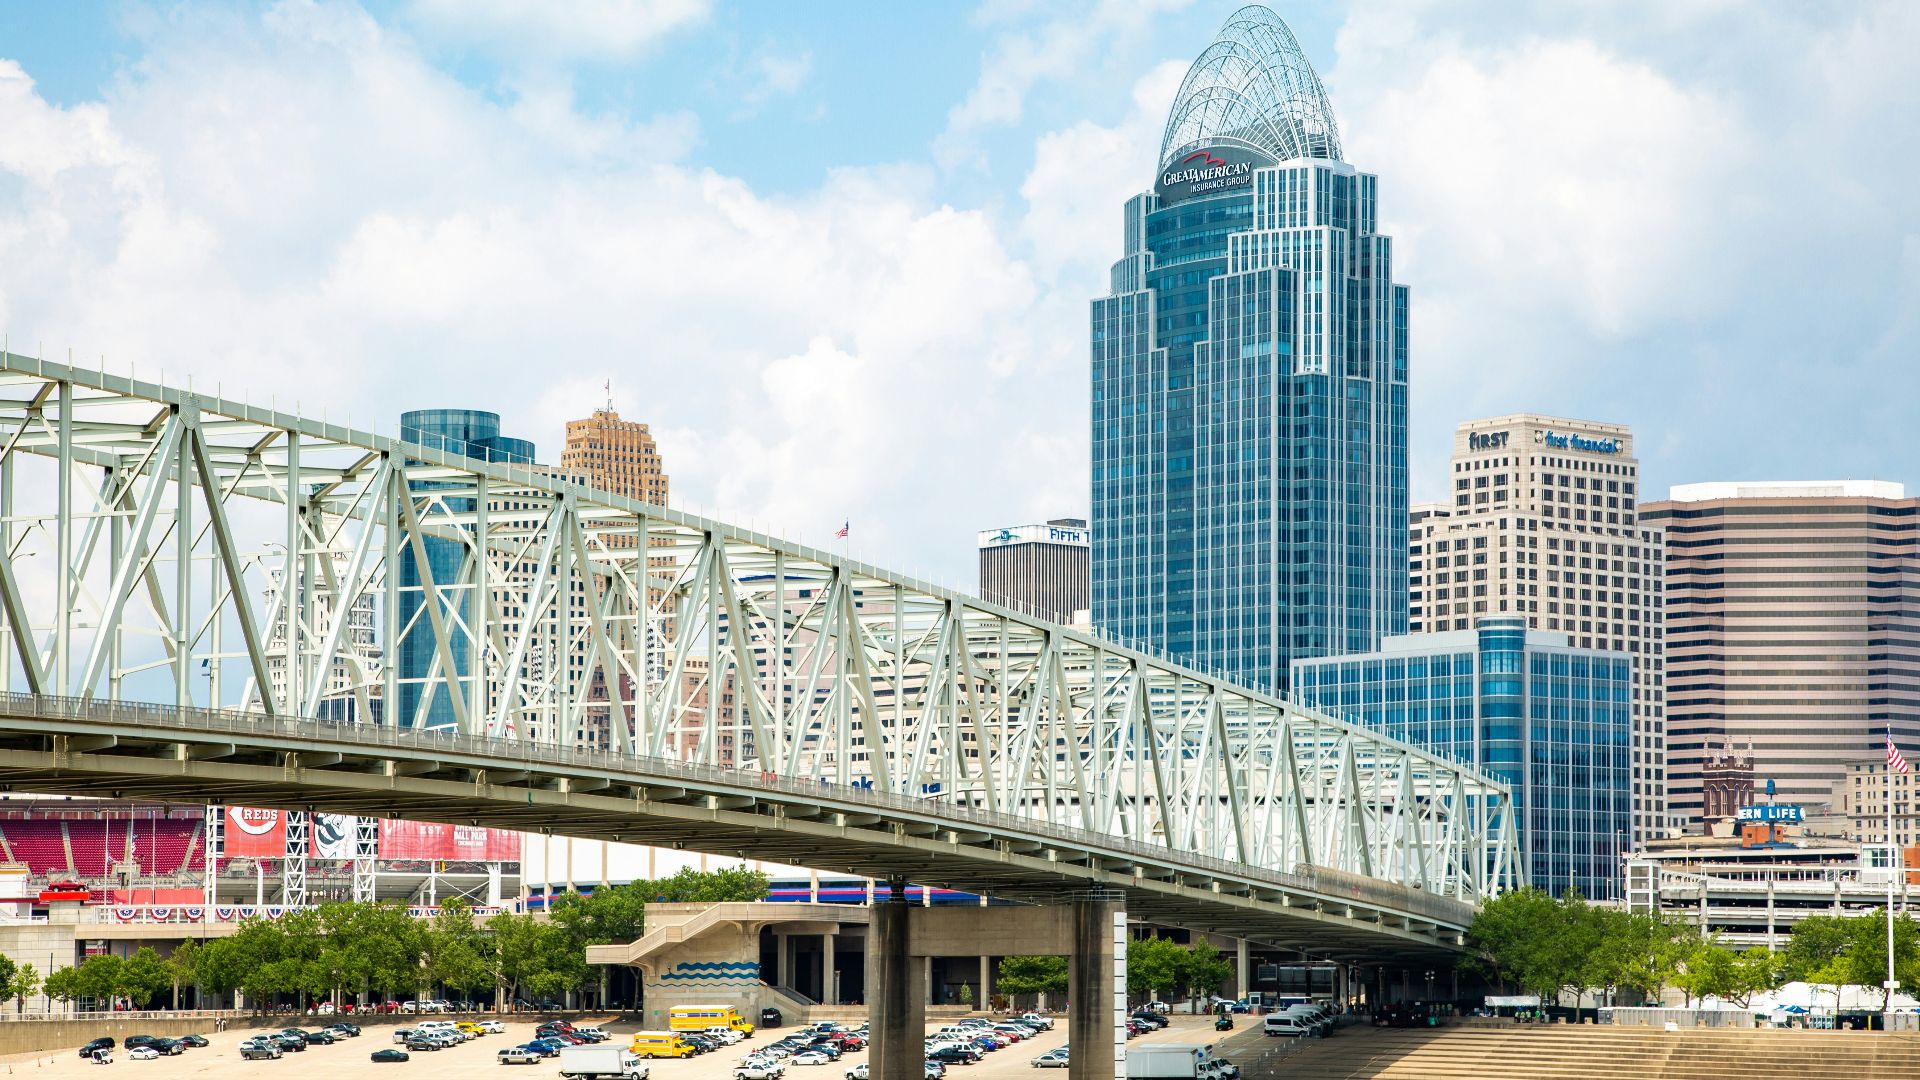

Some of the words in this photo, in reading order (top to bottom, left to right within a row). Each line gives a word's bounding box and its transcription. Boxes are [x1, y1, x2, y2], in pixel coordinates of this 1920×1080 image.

[1191, 179, 1225, 193] INSURANCE
[1227, 175, 1251, 186] GROUP
[1050, 528, 1080, 542] FIFTH
[243, 809, 278, 820] REDS
[1768, 808, 1796, 819] LIFE
